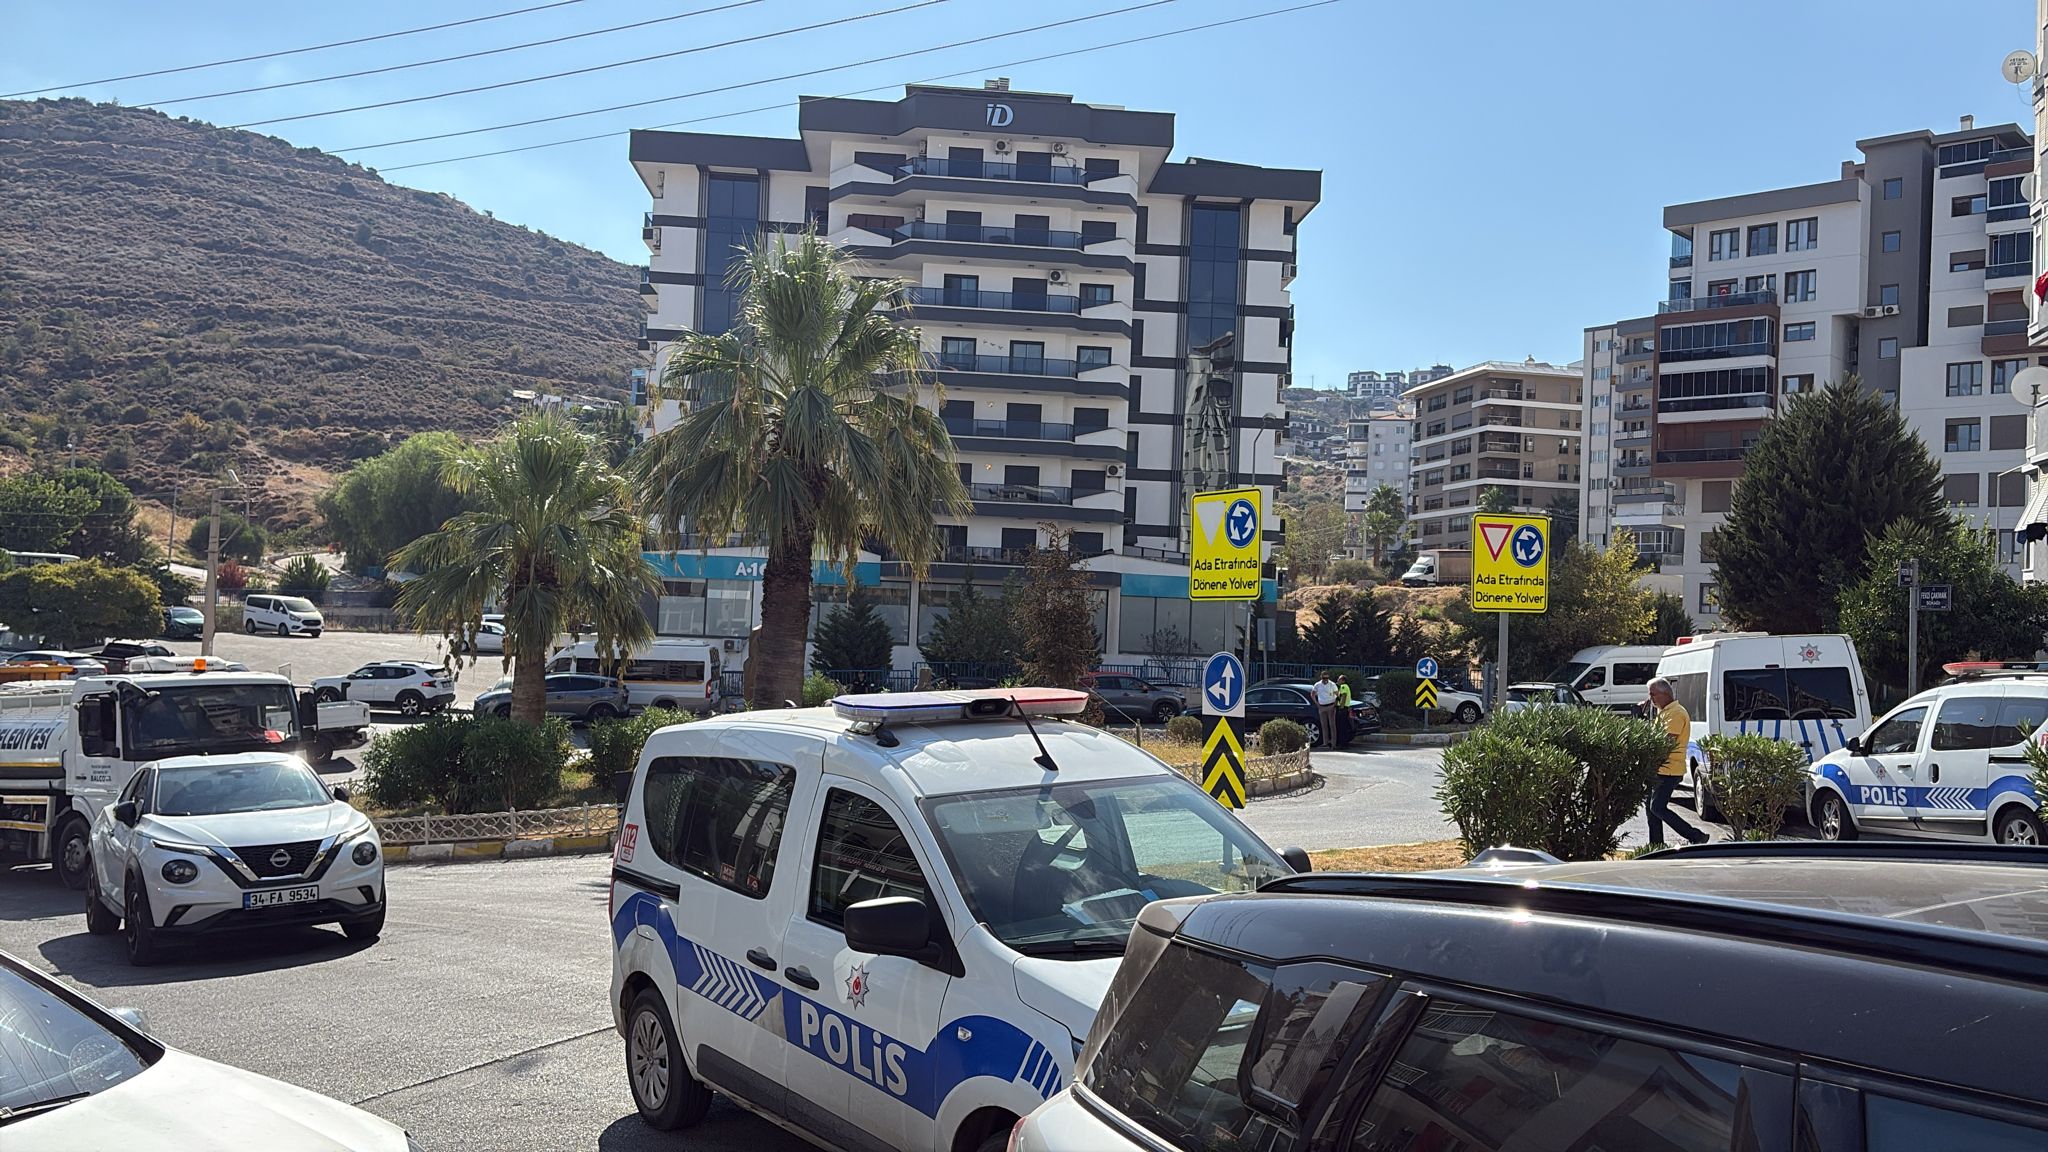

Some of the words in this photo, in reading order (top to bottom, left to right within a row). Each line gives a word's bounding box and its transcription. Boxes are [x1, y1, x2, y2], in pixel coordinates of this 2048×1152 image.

[1194, 558, 1212, 571] Ada
[1214, 557, 1258, 570] Etrafında
[1193, 578, 1228, 591] Dönene
[1229, 577, 1258, 589] Yolver
[1476, 573, 1496, 585] Ada
[1499, 573, 1544, 586] Etrafında
[1475, 591, 1513, 603] Dönene
[1515, 592, 1544, 604] Yolver
[623, 827, 637, 848] 112
[251, 894, 264, 905] 34
[269, 892, 283, 904] FA
[289, 888, 316, 901] 9534
